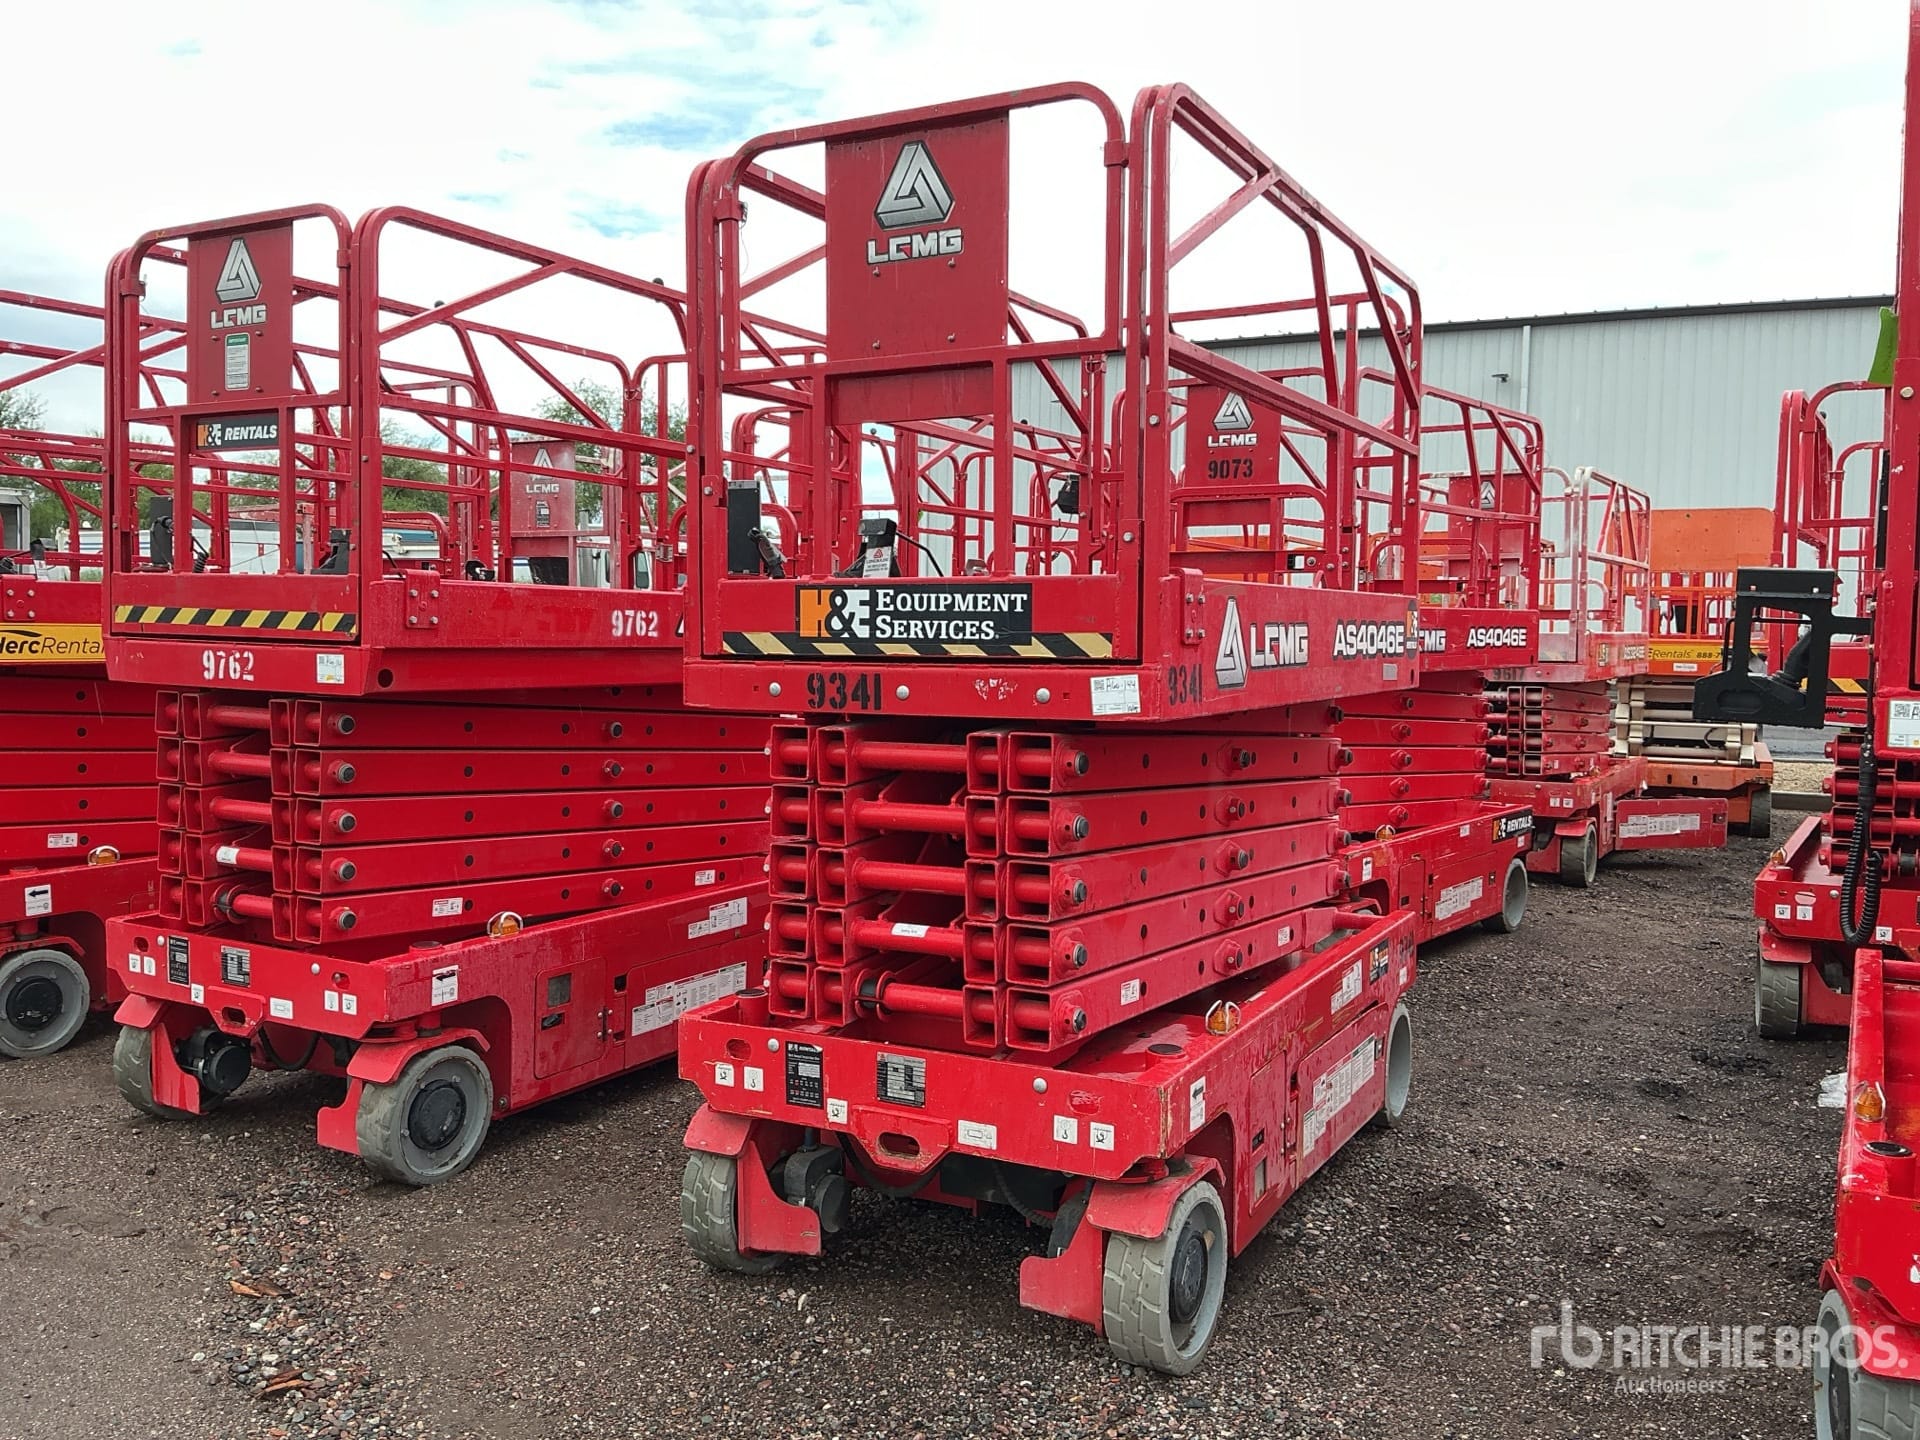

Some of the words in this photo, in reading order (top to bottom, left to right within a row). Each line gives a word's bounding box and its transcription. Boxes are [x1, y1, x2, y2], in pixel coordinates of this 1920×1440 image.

[197, 423, 222, 447] H&E
[224, 424, 278, 441] RENTALS
[1208, 458, 1253, 479] 9073
[611, 609, 659, 637] 9762
[799, 588, 870, 638] H&E
[0, 636, 105, 654] ercRenta
[1333, 622, 1405, 658] AS4046E
[1466, 626, 1528, 649] AS4046E
[202, 649, 255, 682] 9762
[806, 672, 883, 711] 9341
[1168, 663, 1203, 706] 9341
[1506, 815, 1532, 833] RENTALS
